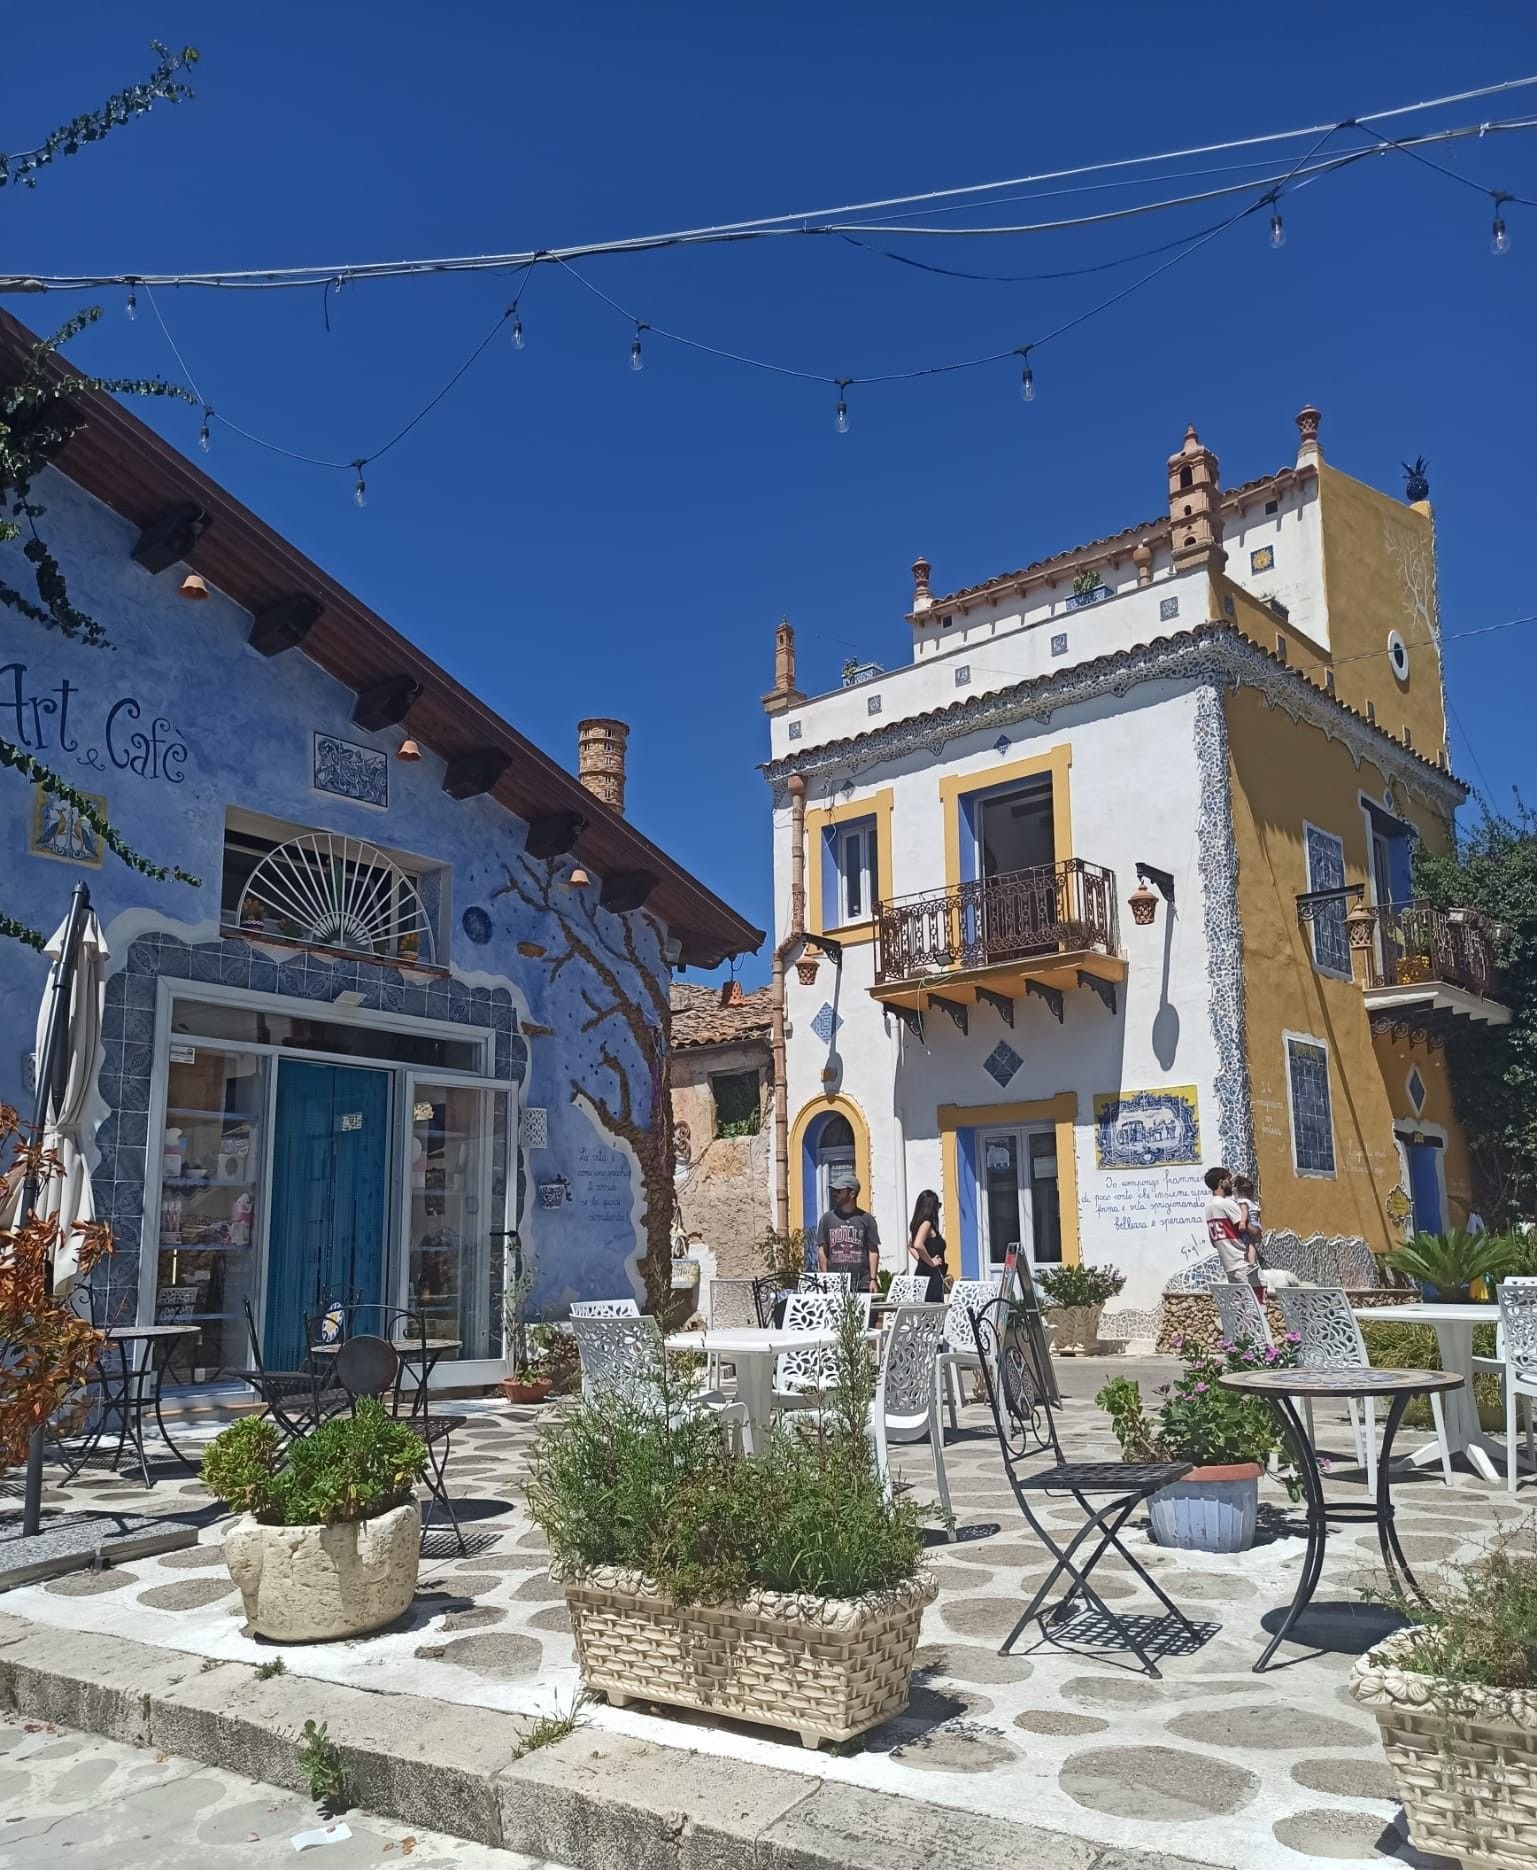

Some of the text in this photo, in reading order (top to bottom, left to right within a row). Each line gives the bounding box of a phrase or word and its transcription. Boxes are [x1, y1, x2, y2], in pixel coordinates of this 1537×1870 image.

[0, 663, 78, 752] Art
[106, 698, 187, 783] Cafè
[1105, 1176, 1118, 1189] Io
[1121, 1179, 1159, 1193] compongo
[1094, 1194, 1111, 1209] poco
[1137, 1187, 1150, 1200] che
[1154, 1189, 1189, 1199] insieme
[1129, 1199, 1147, 1212] vita
[1150, 1197, 1205, 1215] sprigionando
[1113, 1215, 1149, 1231] bellezza
[1159, 1216, 1203, 1232] speranza
